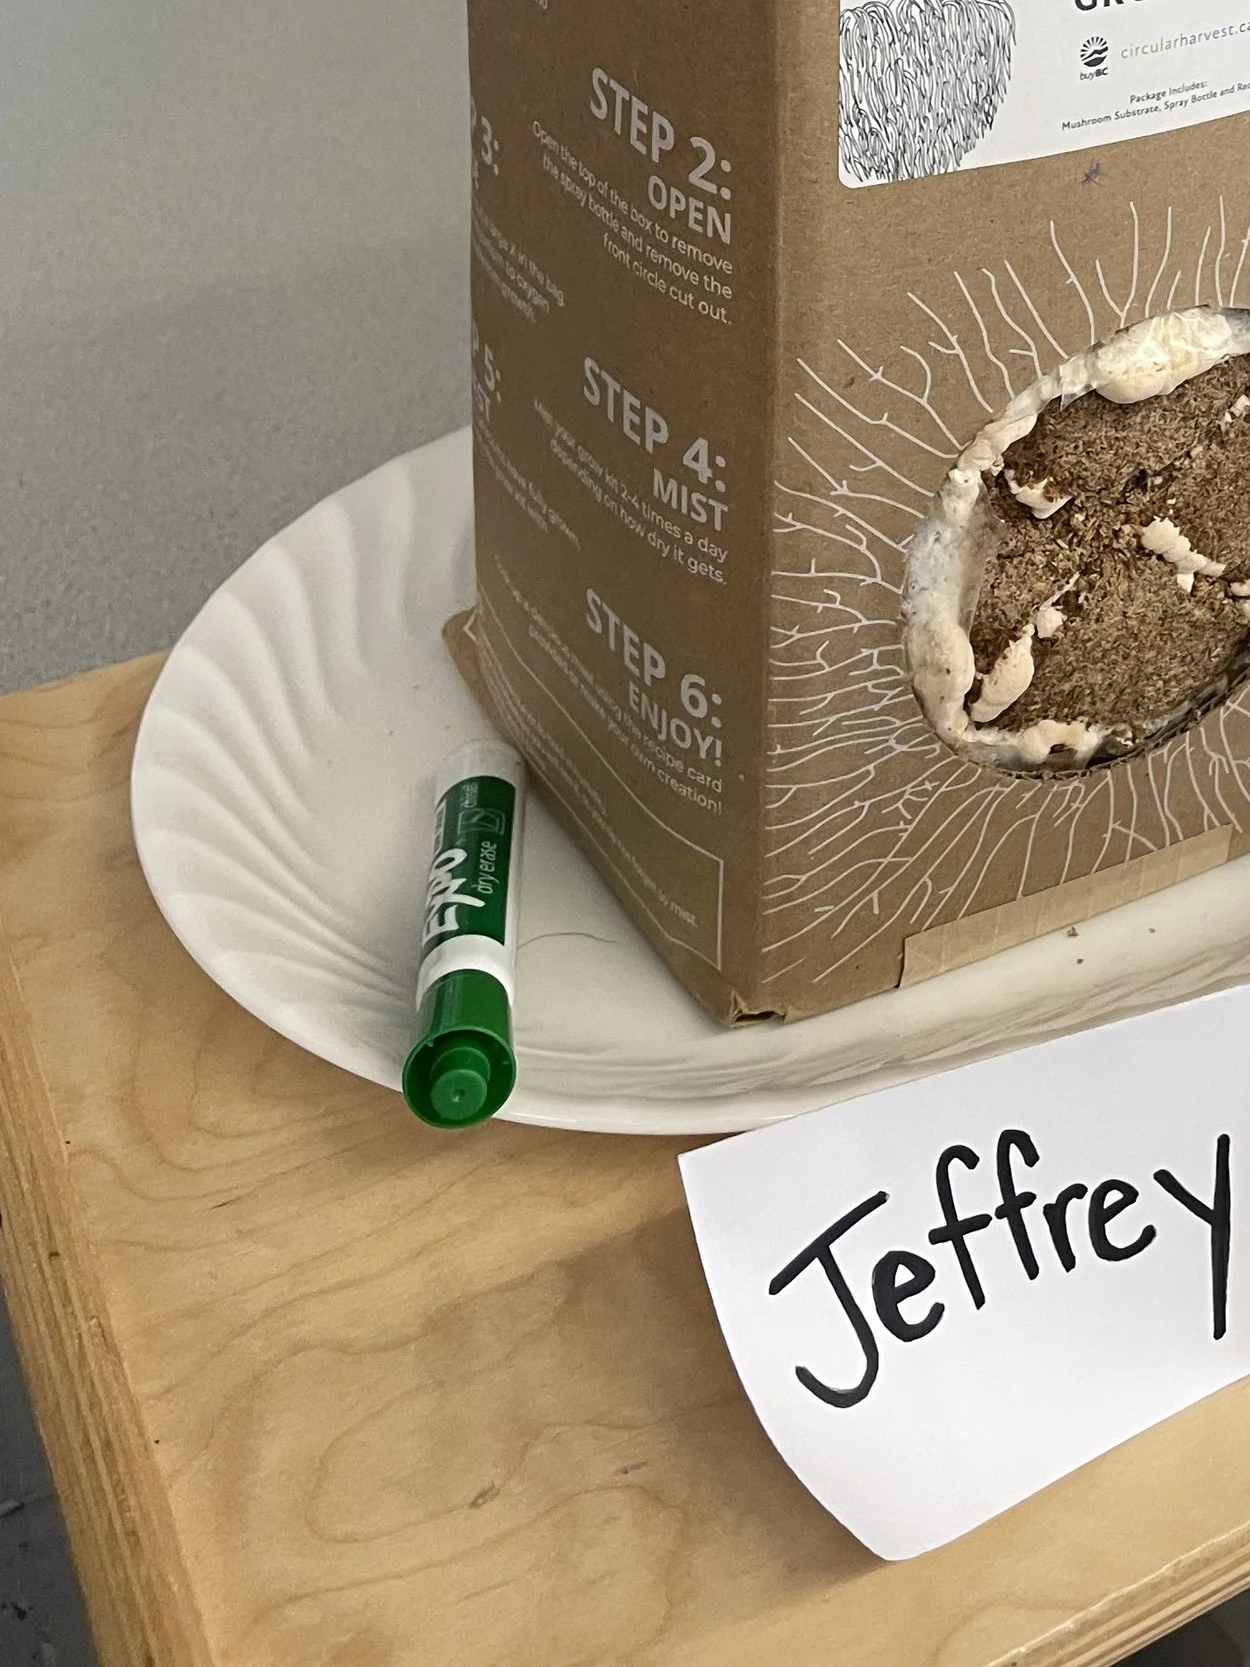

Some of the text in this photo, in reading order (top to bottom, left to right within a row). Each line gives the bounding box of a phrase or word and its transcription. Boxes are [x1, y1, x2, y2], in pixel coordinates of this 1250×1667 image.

[590, 67, 732, 200] STEP 2:
[1061, 114, 1112, 131] Mushroom
[1114, 103, 1162, 120] Substrate,
[1164, 97, 1189, 111] Spray
[1191, 90, 1218, 104] Bottle
[1220, 84, 1235, 97] and
[1129, 80, 1208, 104] Package Includes:
[533, 121, 733, 274] Open the top of the box to remove
[543, 153, 732, 299] the spray bottle and remove the
[648, 174, 731, 245] OPEN
[604, 232, 732, 325] front circle cut out.
[584, 357, 726, 492] STEP 4:
[604, 494, 617, 515] on
[620, 505, 645, 539] how
[648, 532, 670, 557] dry
[674, 545, 684, 564] it
[688, 557, 727, 584] gets.
[620, 483, 639, 509] 2-4
[642, 502, 681, 538] times
[684, 532, 694, 545] a
[698, 537, 728, 563] day
[654, 468, 728, 531] MIST
[587, 588, 666, 686] STEP
[681, 673, 722, 728] 6:
[628, 679, 722, 767] ENJOY!
[644, 734, 684, 773] recipe
[687, 767, 722, 793] card
[658, 769, 722, 815] creation!
[472, 840, 500, 895] dry erase
[768, 1129, 1231, 1409] Jeffrey
